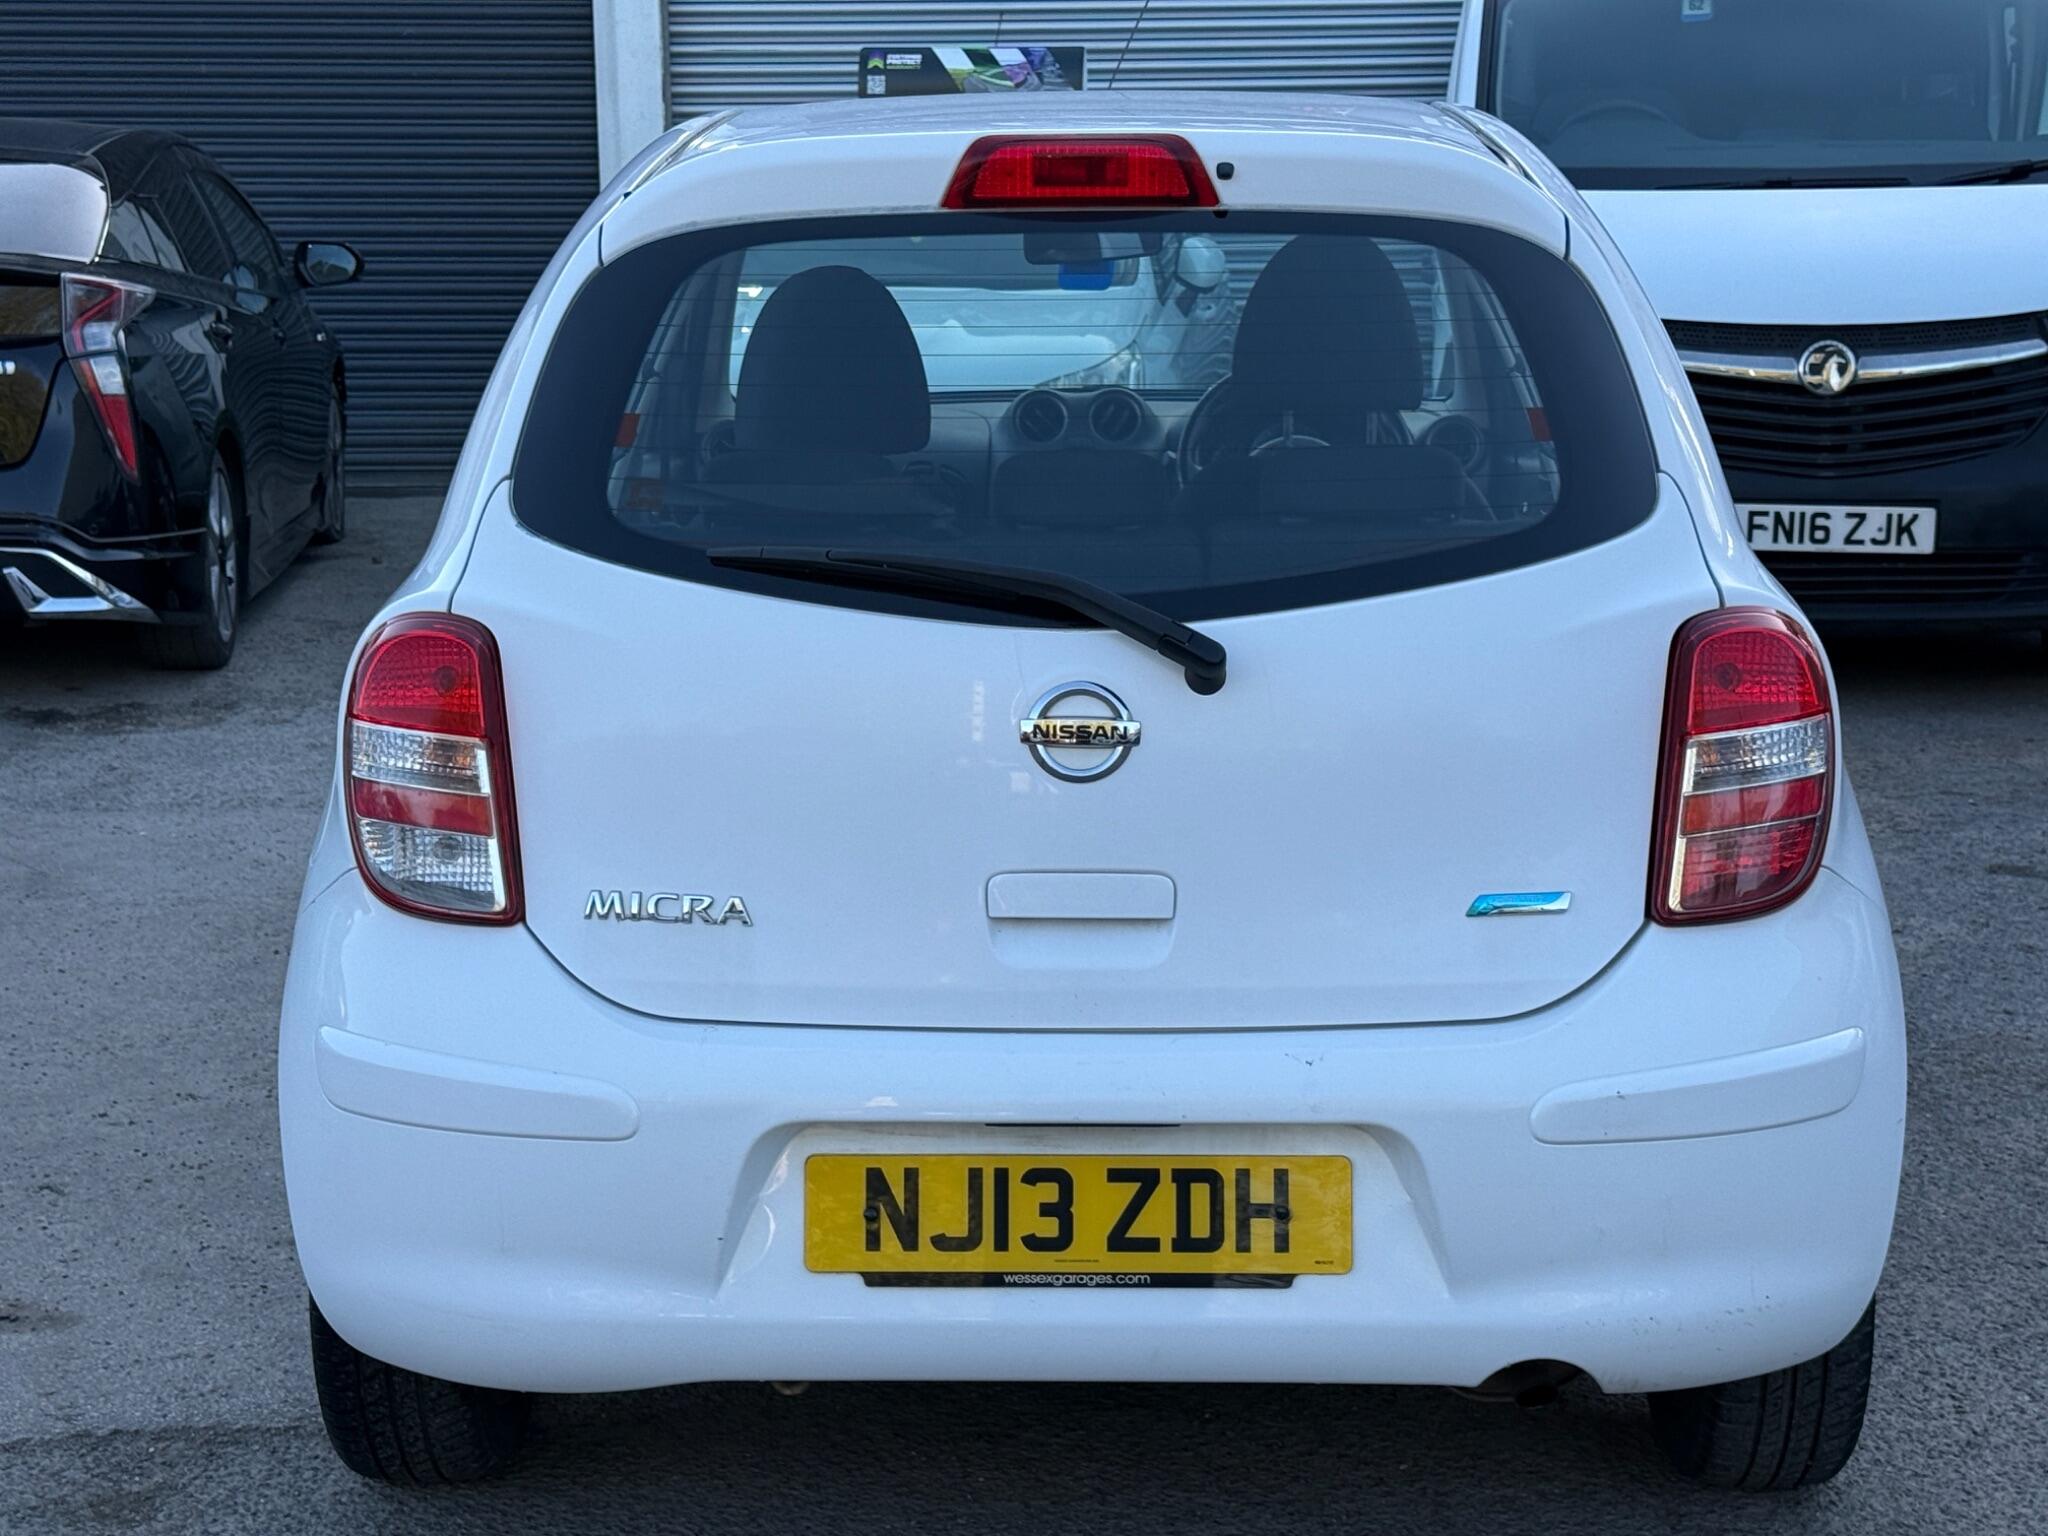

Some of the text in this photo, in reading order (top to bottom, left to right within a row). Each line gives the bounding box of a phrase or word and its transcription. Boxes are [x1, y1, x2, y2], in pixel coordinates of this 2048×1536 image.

[1748, 510, 1919, 547] FN16 ZJK
[1032, 723, 1128, 740] NISSAN
[584, 889, 753, 927] MICRA
[864, 1166, 1290, 1253] NJ13 ZDH
[1003, 1273, 1151, 1287] wessexgarages.com
